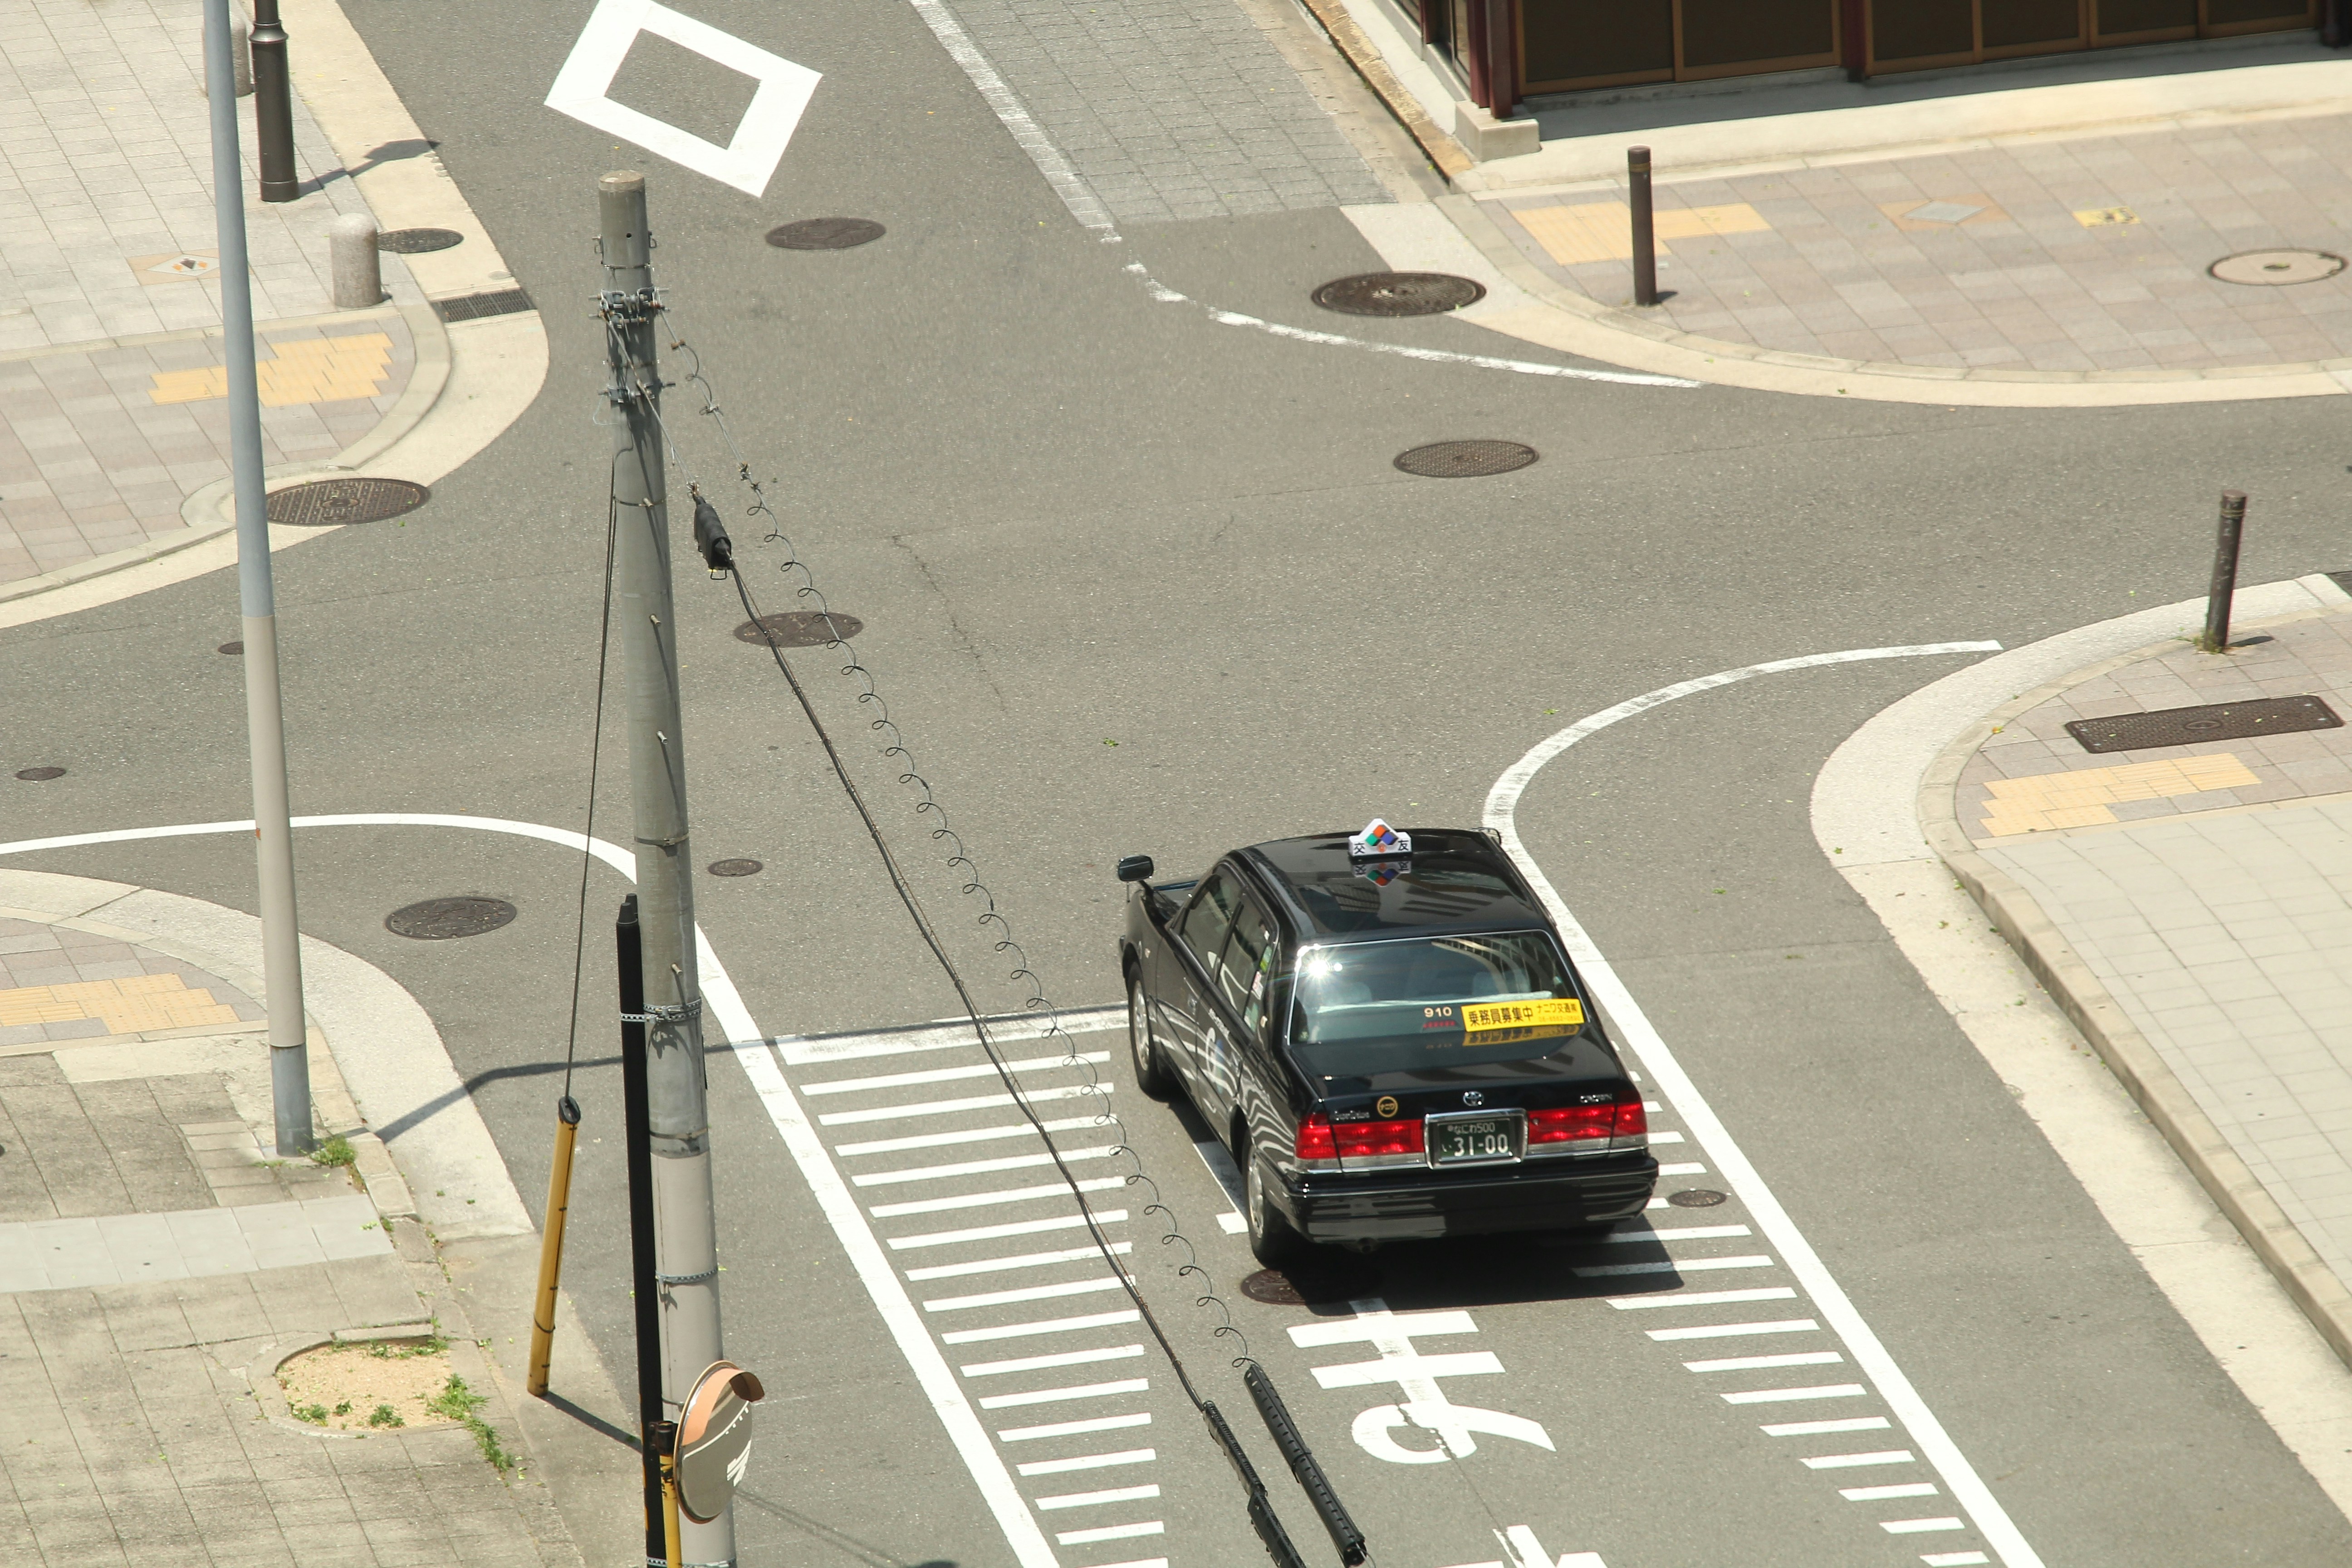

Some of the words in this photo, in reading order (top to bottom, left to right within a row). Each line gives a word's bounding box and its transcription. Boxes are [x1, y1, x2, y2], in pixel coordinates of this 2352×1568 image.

[1354, 843, 1365, 854] 交
[1398, 839, 1409, 851] 友
[1424, 1006, 1452, 1018] 910
[1469, 1006, 1533, 1026] 乗務員募集中
[1454, 1133, 1509, 1156] 31-00
